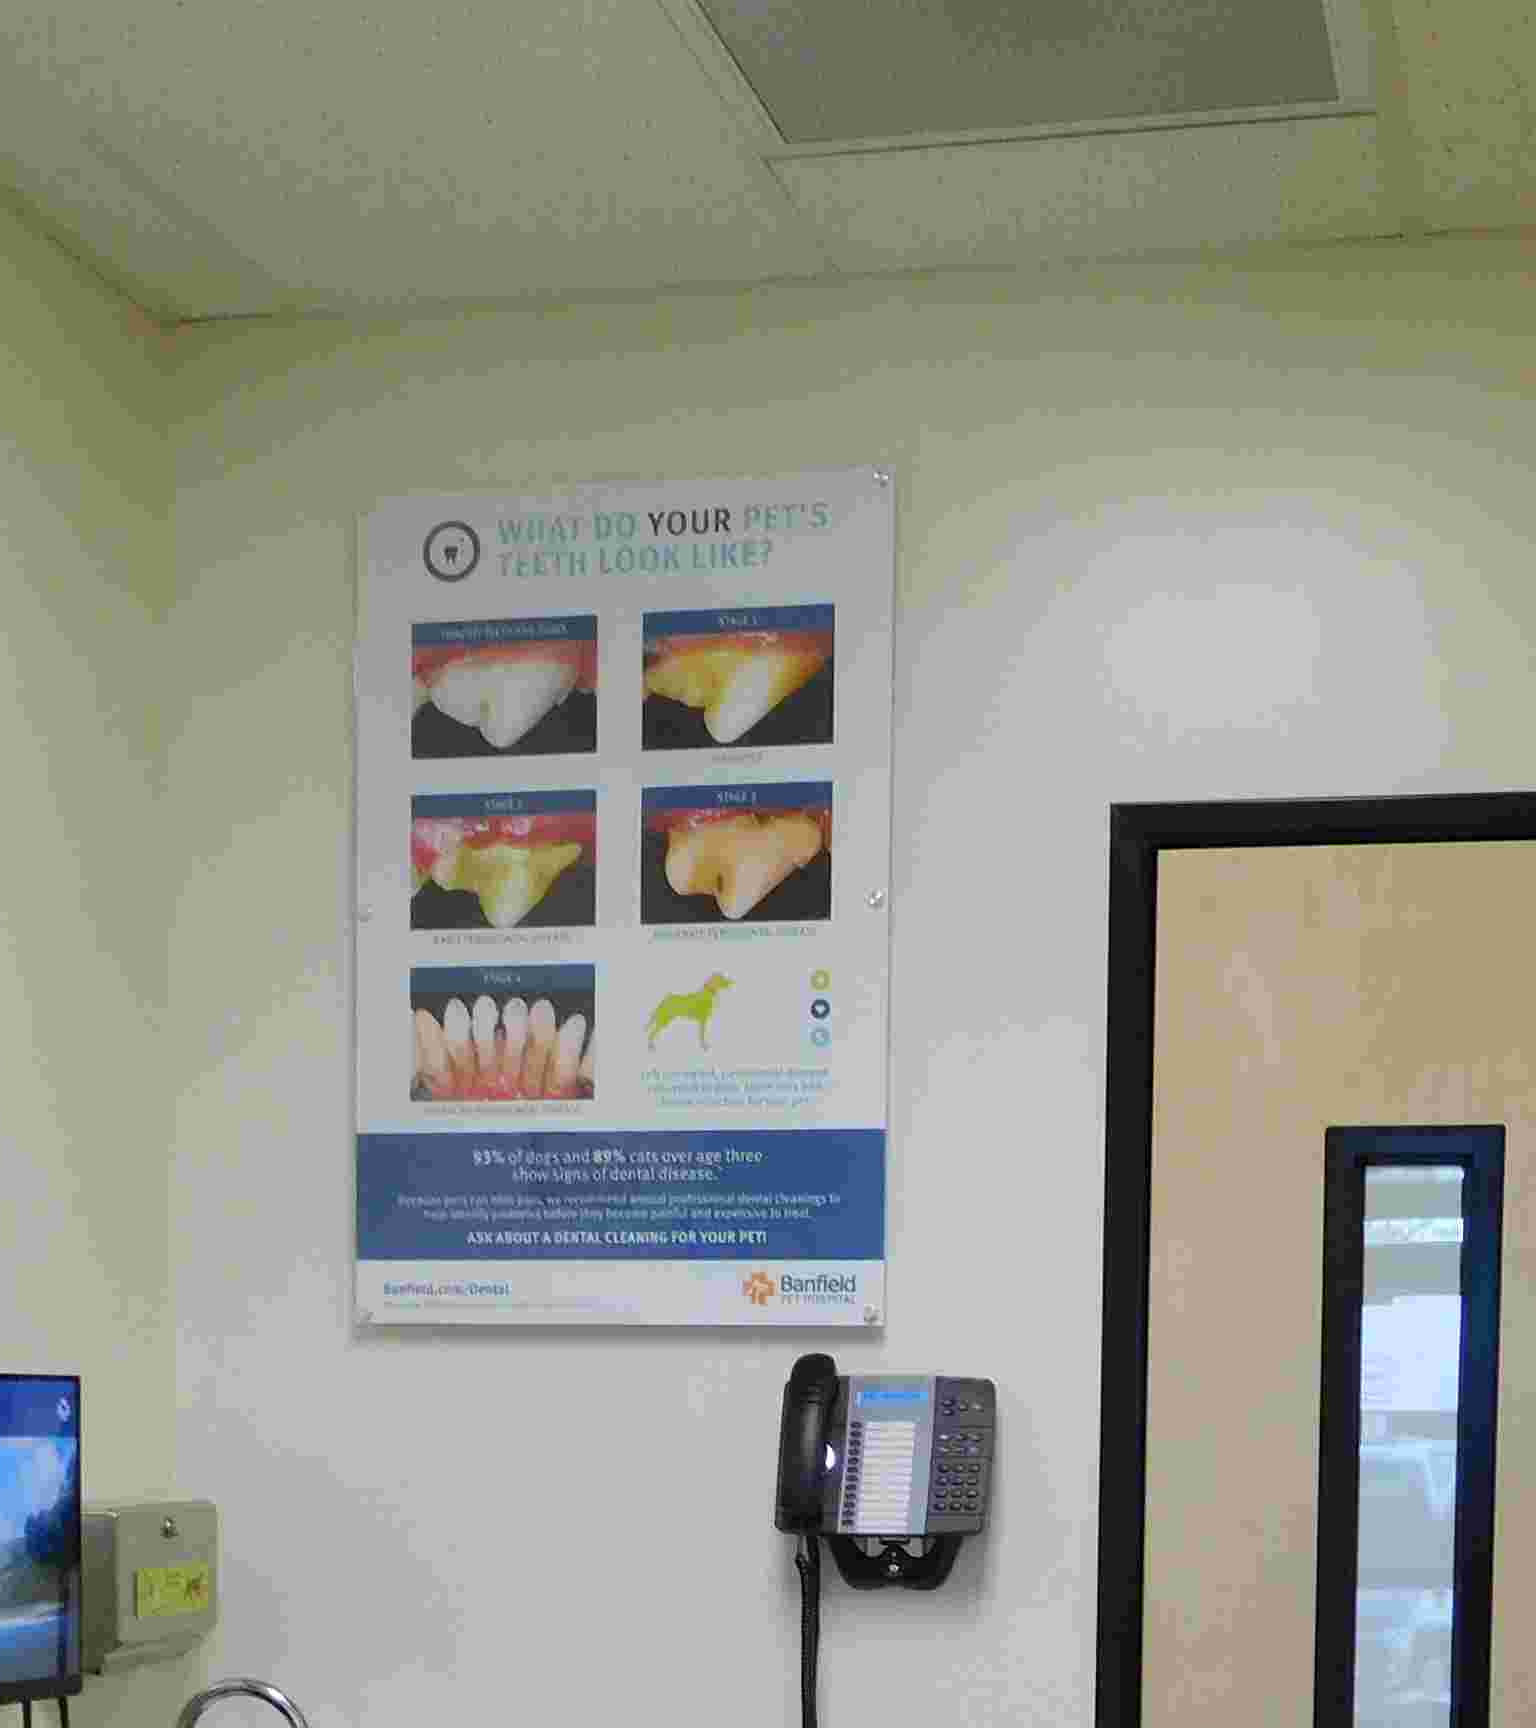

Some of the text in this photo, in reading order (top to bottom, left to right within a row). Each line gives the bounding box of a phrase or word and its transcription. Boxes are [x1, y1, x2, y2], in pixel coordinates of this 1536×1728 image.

[496, 501, 830, 545] WHAT DO YOUR PET'S
[496, 538, 773, 577] TEETH LOOK LIKE?
[507, 1149, 522, 1164] of
[526, 1149, 561, 1167] dogs
[563, 1149, 590, 1163] and
[629, 1150, 659, 1163] cats
[663, 1151, 692, 1163] over
[696, 1151, 722, 1166] age
[725, 1147, 763, 1163] three
[512, 1167, 547, 1182] show
[552, 1167, 588, 1185] signs
[592, 1167, 608, 1182] of
[610, 1167, 656, 1182] dental
[467, 1231, 493, 1245] ASK
[496, 1231, 541, 1245] ABOUT
[543, 1231, 552, 1244] A
[554, 1231, 601, 1245] DENTAL
[604, 1231, 667, 1245] CLEANING
[671, 1231, 696, 1244] FOR
[699, 1231, 736, 1244] YOUR
[781, 1273, 856, 1293] Banfield
